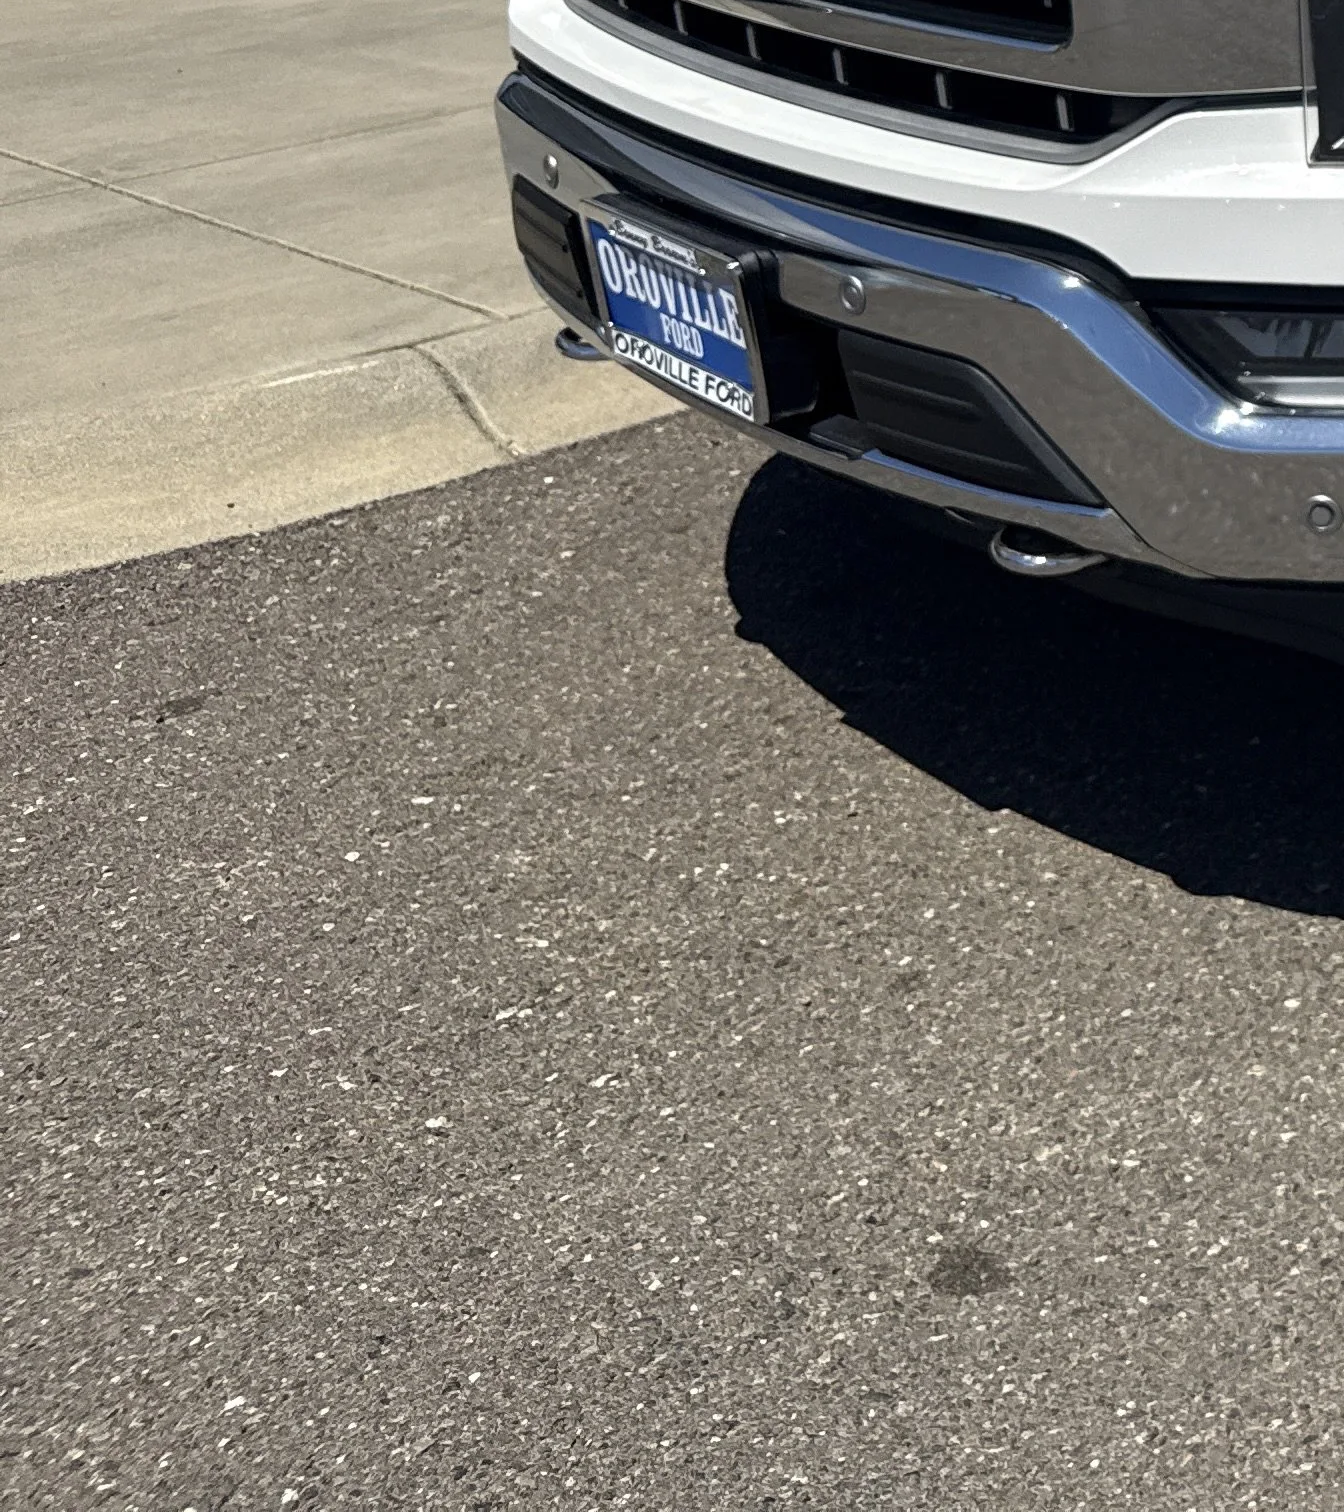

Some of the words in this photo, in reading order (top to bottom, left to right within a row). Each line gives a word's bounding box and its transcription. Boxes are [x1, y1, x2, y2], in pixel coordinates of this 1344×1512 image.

[597, 237, 747, 350] OROVILLE
[660, 312, 704, 359] FORD
[614, 333, 699, 391] OROVILLE
[704, 374, 753, 417] FORD
